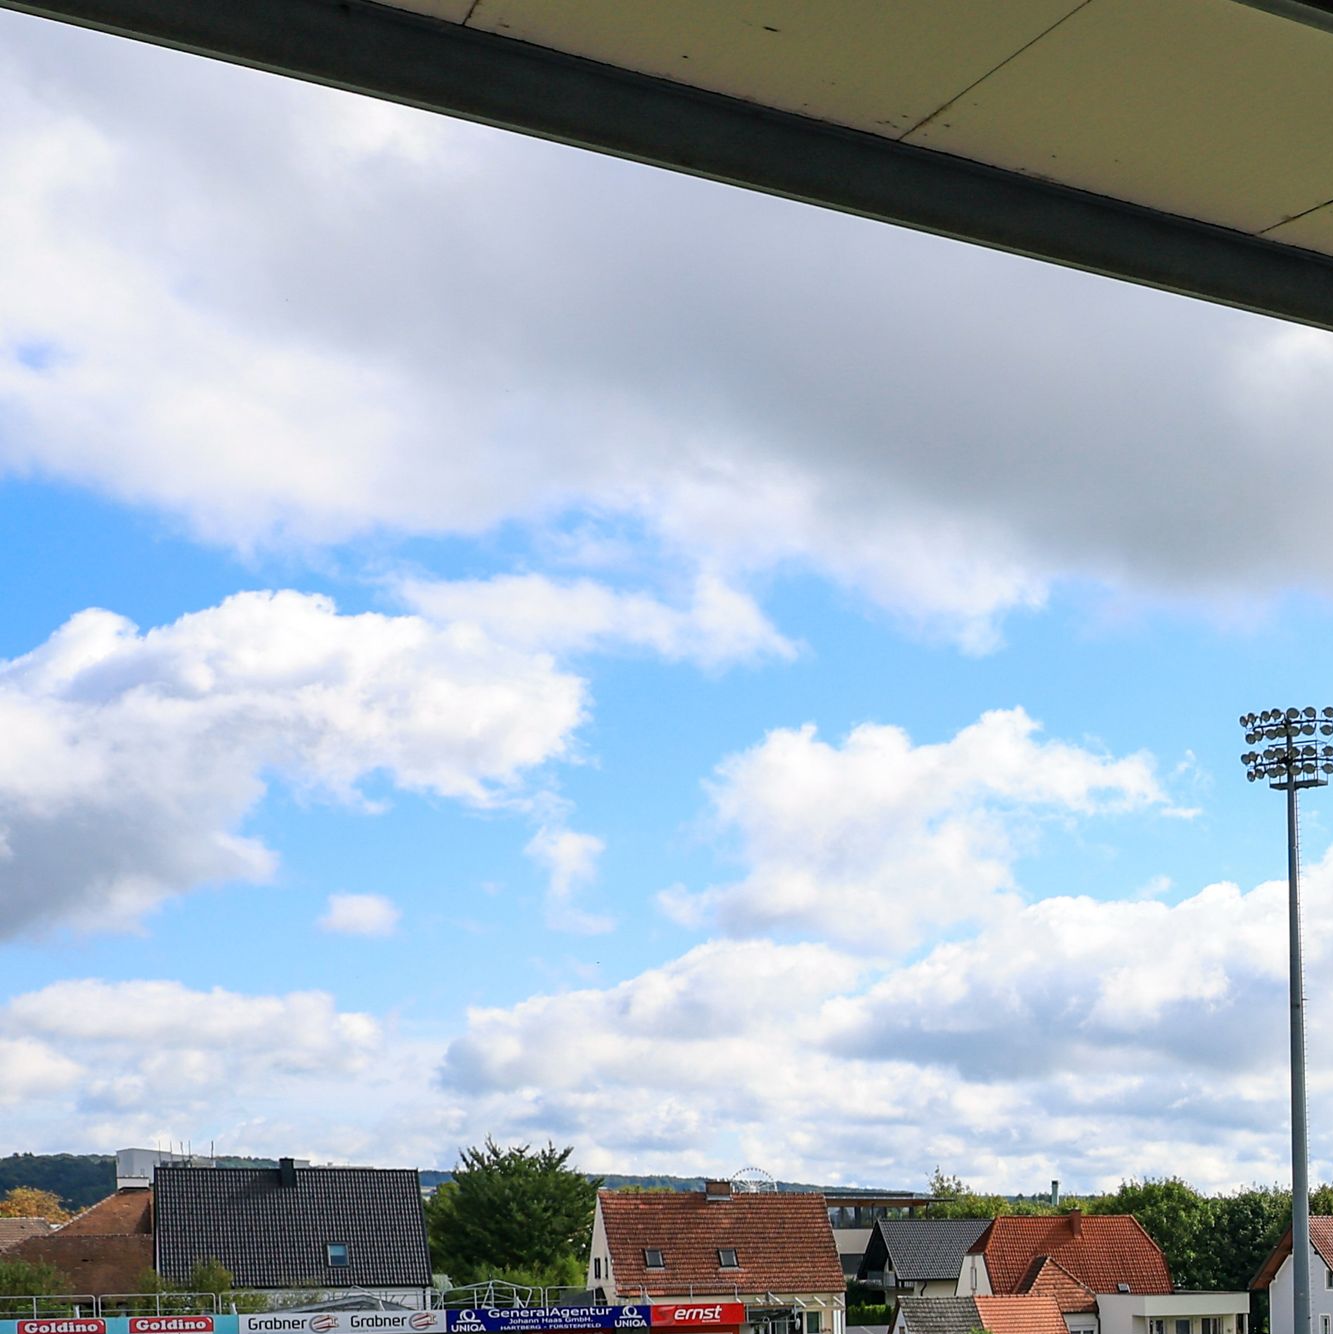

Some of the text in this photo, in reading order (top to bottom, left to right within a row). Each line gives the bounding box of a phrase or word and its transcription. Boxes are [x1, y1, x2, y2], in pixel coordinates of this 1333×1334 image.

[674, 1305, 722, 1320] ernst
[136, 1320, 206, 1332] Goldino
[248, 1317, 307, 1331] Grabner
[350, 1315, 407, 1328] Grabner
[508, 1317, 540, 1325] Johann
[549, 1322, 602, 1330] FÜRSTENFELD
[614, 1319, 648, 1329] UNIQA
[24, 1322, 98, 1334] Goldino
[451, 1323, 487, 1333] UNIQA
